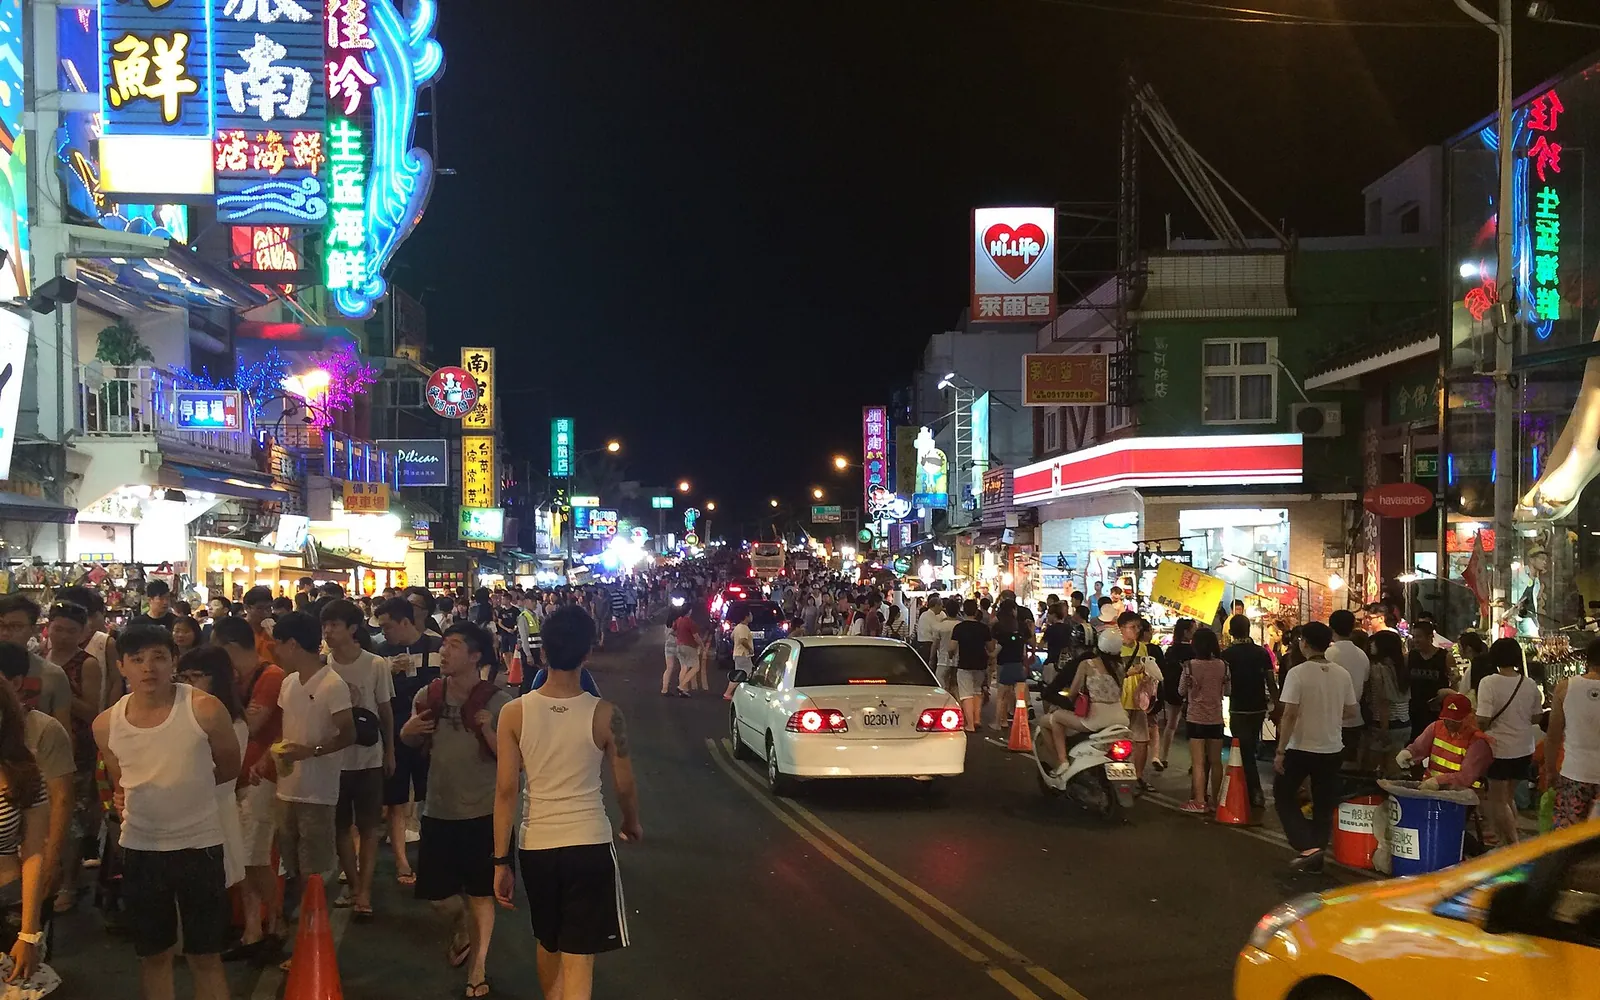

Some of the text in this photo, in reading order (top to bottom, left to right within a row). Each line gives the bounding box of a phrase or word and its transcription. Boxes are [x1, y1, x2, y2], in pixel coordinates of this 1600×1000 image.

[109, 0, 197, 122] 鮮
[216, 130, 326, 176] 活海鮮
[979, 296, 1050, 316] 萊爾富
[180, 400, 224, 422] 停車場
[864, 714, 899, 726] 0230-VY
